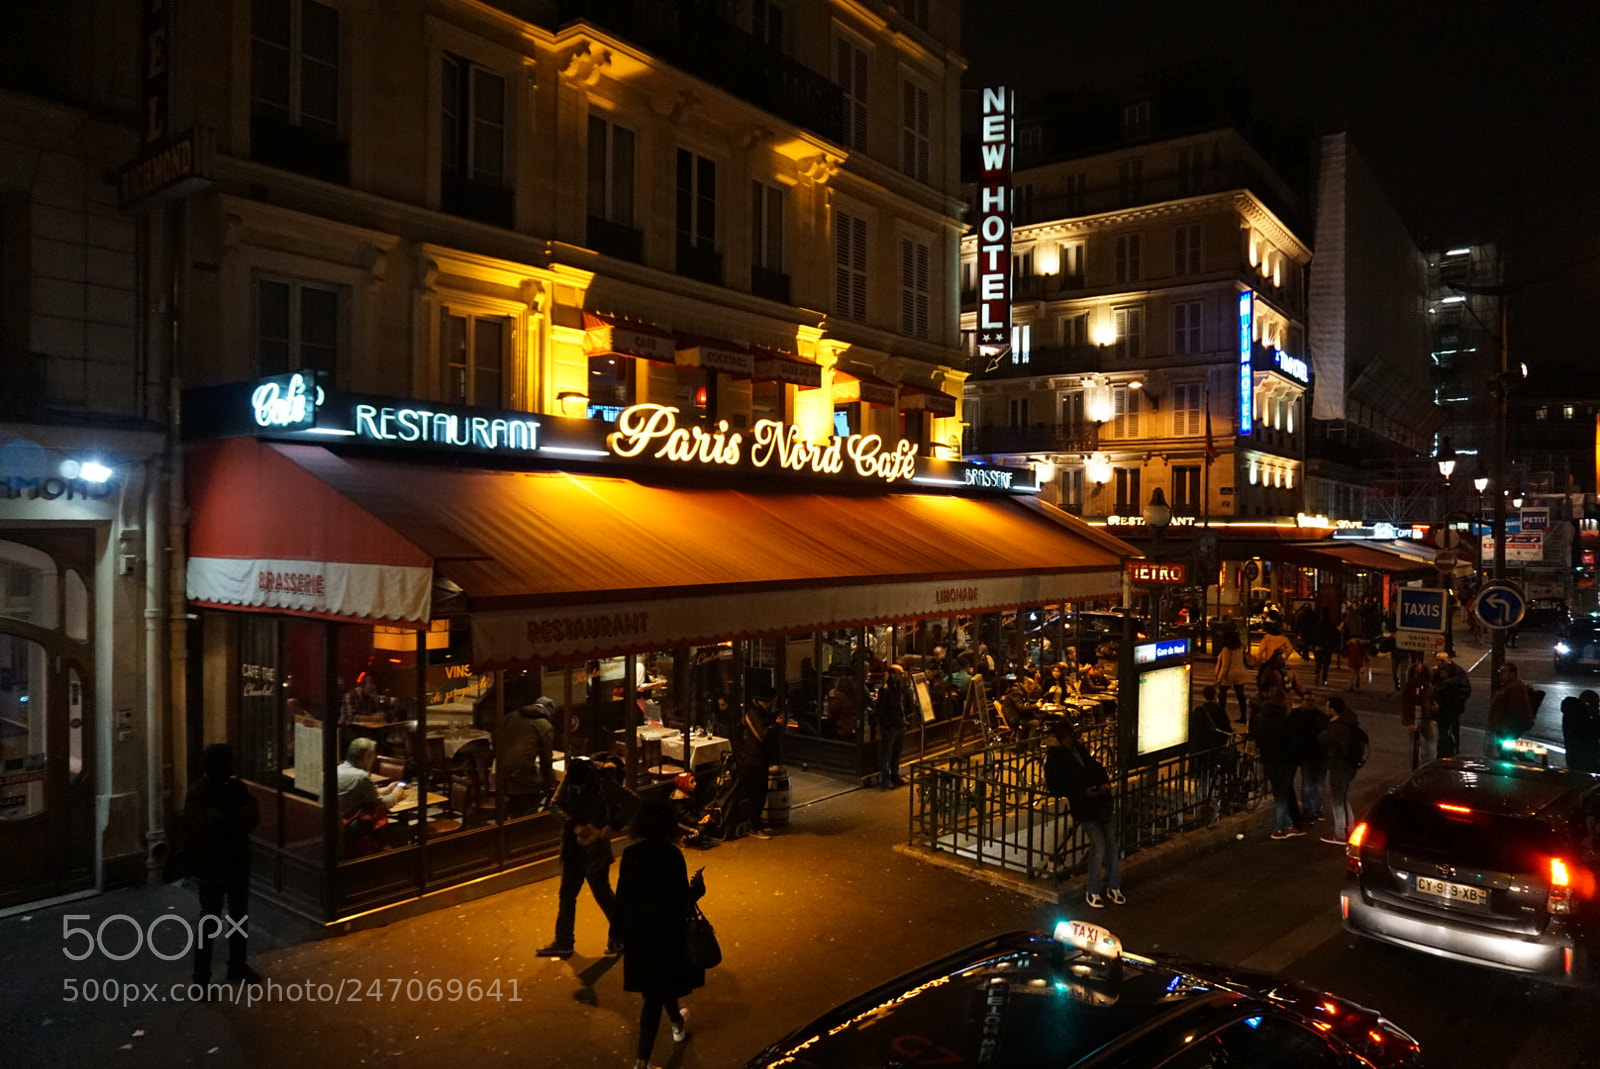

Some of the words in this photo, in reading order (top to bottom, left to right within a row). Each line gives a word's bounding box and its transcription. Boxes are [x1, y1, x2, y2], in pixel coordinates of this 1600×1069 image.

[982, 86, 1006, 172] NEW
[981, 186, 1005, 330] HOTEL
[356, 405, 541, 450] RESTAURANT
[611, 403, 740, 465] Paris
[750, 418, 843, 474] Nord
[847, 433, 919, 484] Café
[965, 468, 1013, 490] BRASSERIE
[1107, 515, 1195, 526] RESTANT
[258, 571, 325, 596] BRASSERIE
[1403, 602, 1441, 618] TAXIS
[527, 612, 649, 644] RESTAURANT
[1418, 878, 1478, 901] CY-99-XB
[1072, 923, 1098, 942] TAXI
